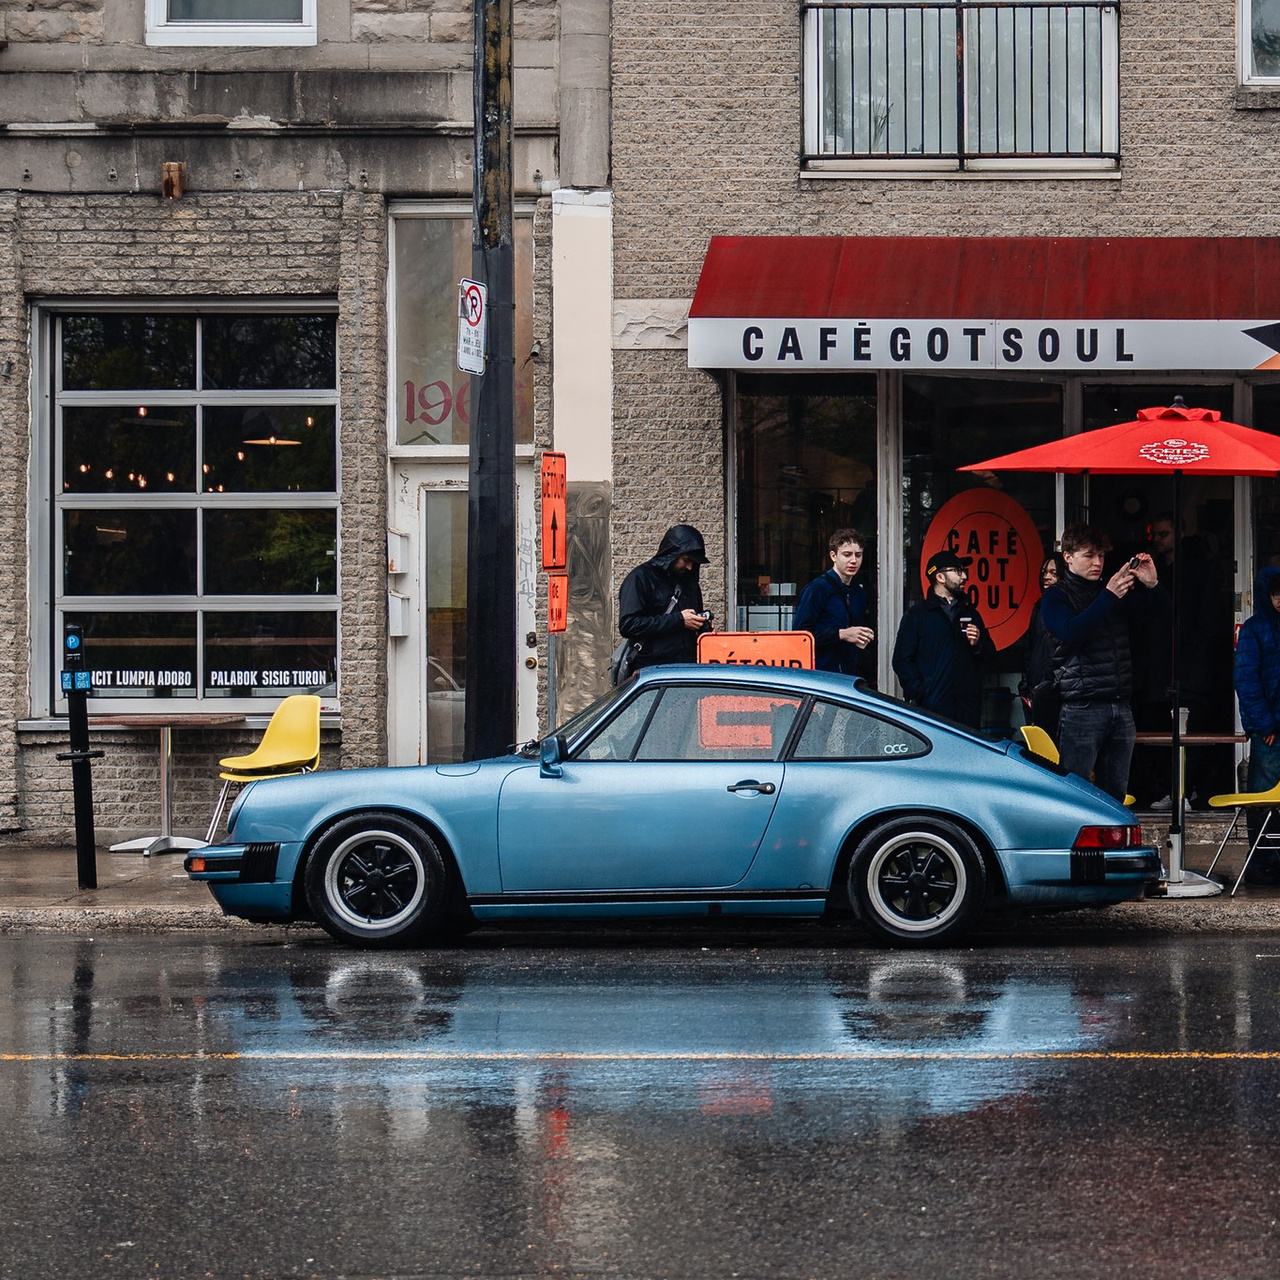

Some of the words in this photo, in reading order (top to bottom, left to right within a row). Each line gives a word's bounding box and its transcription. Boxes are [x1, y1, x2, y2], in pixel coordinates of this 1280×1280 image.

[967, 558, 1009, 582] OT
[967, 585, 1019, 609] OUL
[77, 672, 88, 680] SP
[116, 671, 155, 685] LUMPIA
[157, 671, 192, 685] ADOBO
[211, 670, 258, 685] PALABOK
[262, 670, 290, 685] SISIG
[292, 670, 326, 685] TURON
[884, 743, 909, 754] OCG
